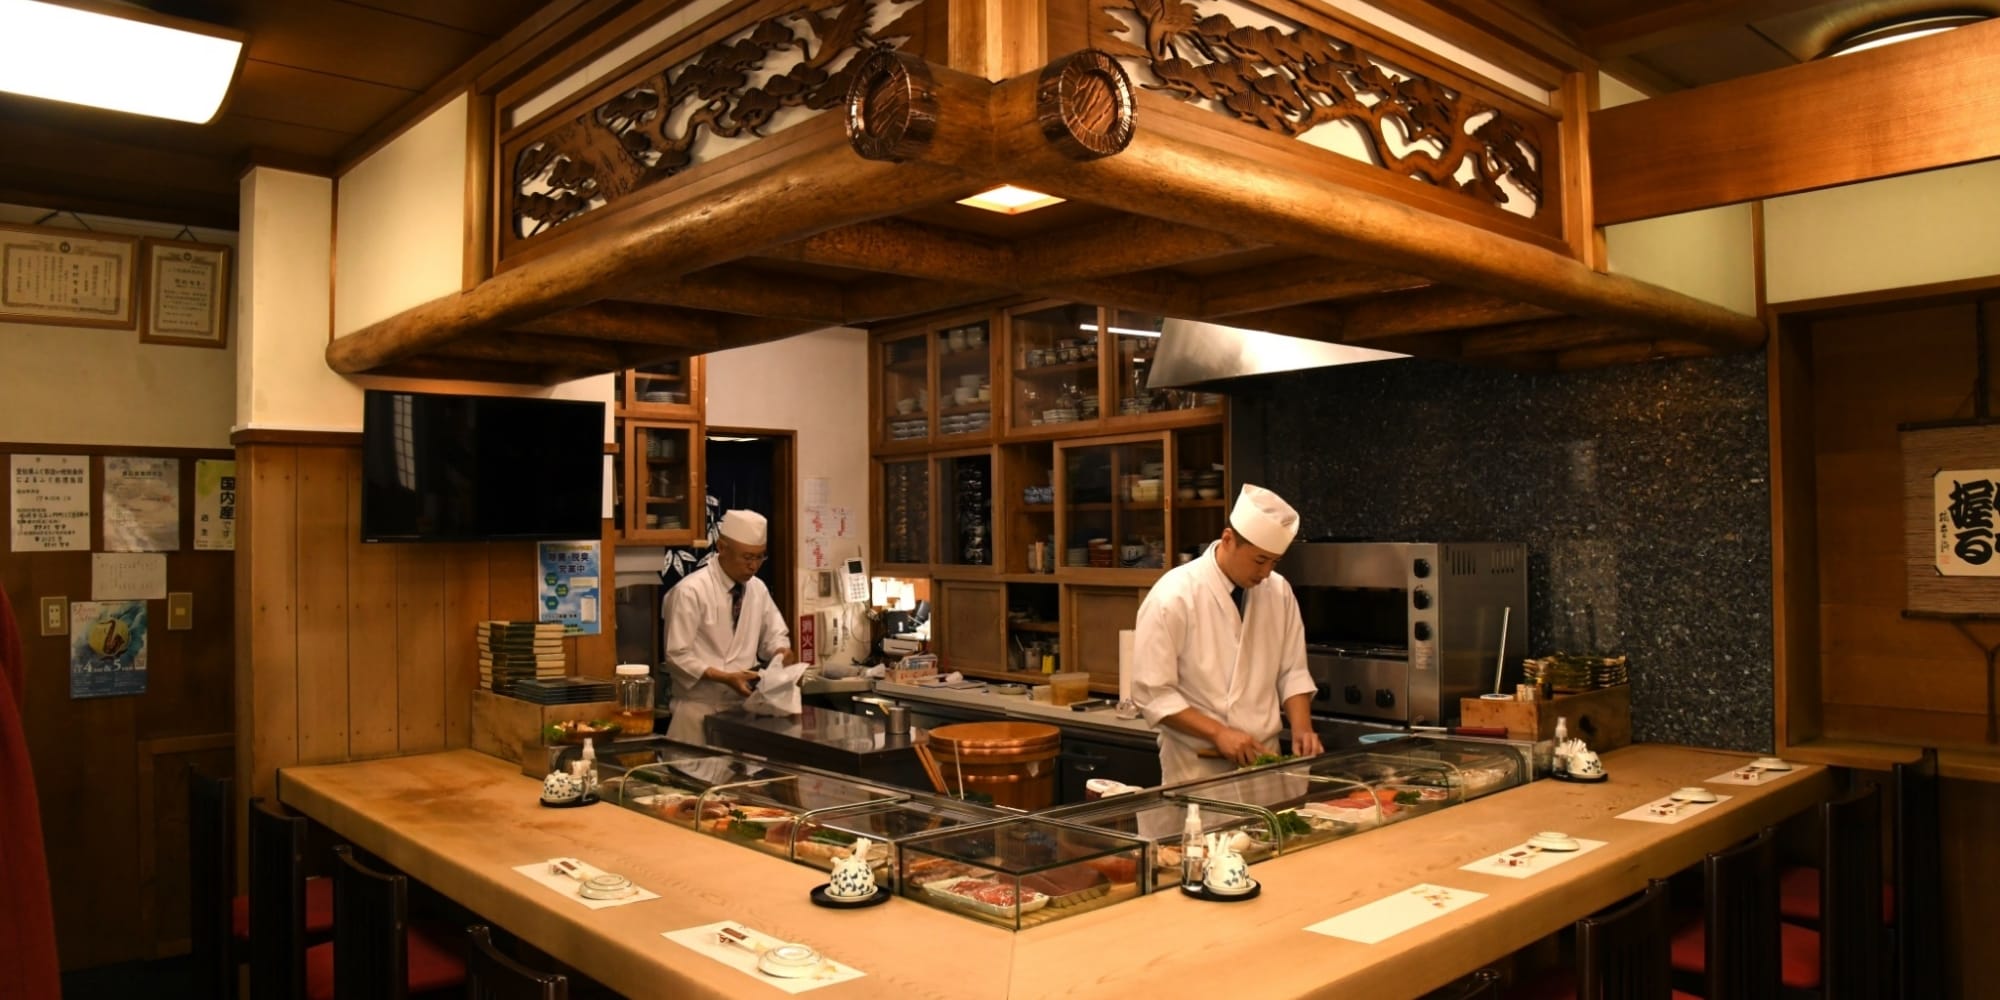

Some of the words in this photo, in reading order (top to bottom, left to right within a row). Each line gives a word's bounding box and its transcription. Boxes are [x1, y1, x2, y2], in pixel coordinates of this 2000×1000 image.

[1948, 479, 1994, 565] 握る
[802, 620, 814, 661] 消火器
